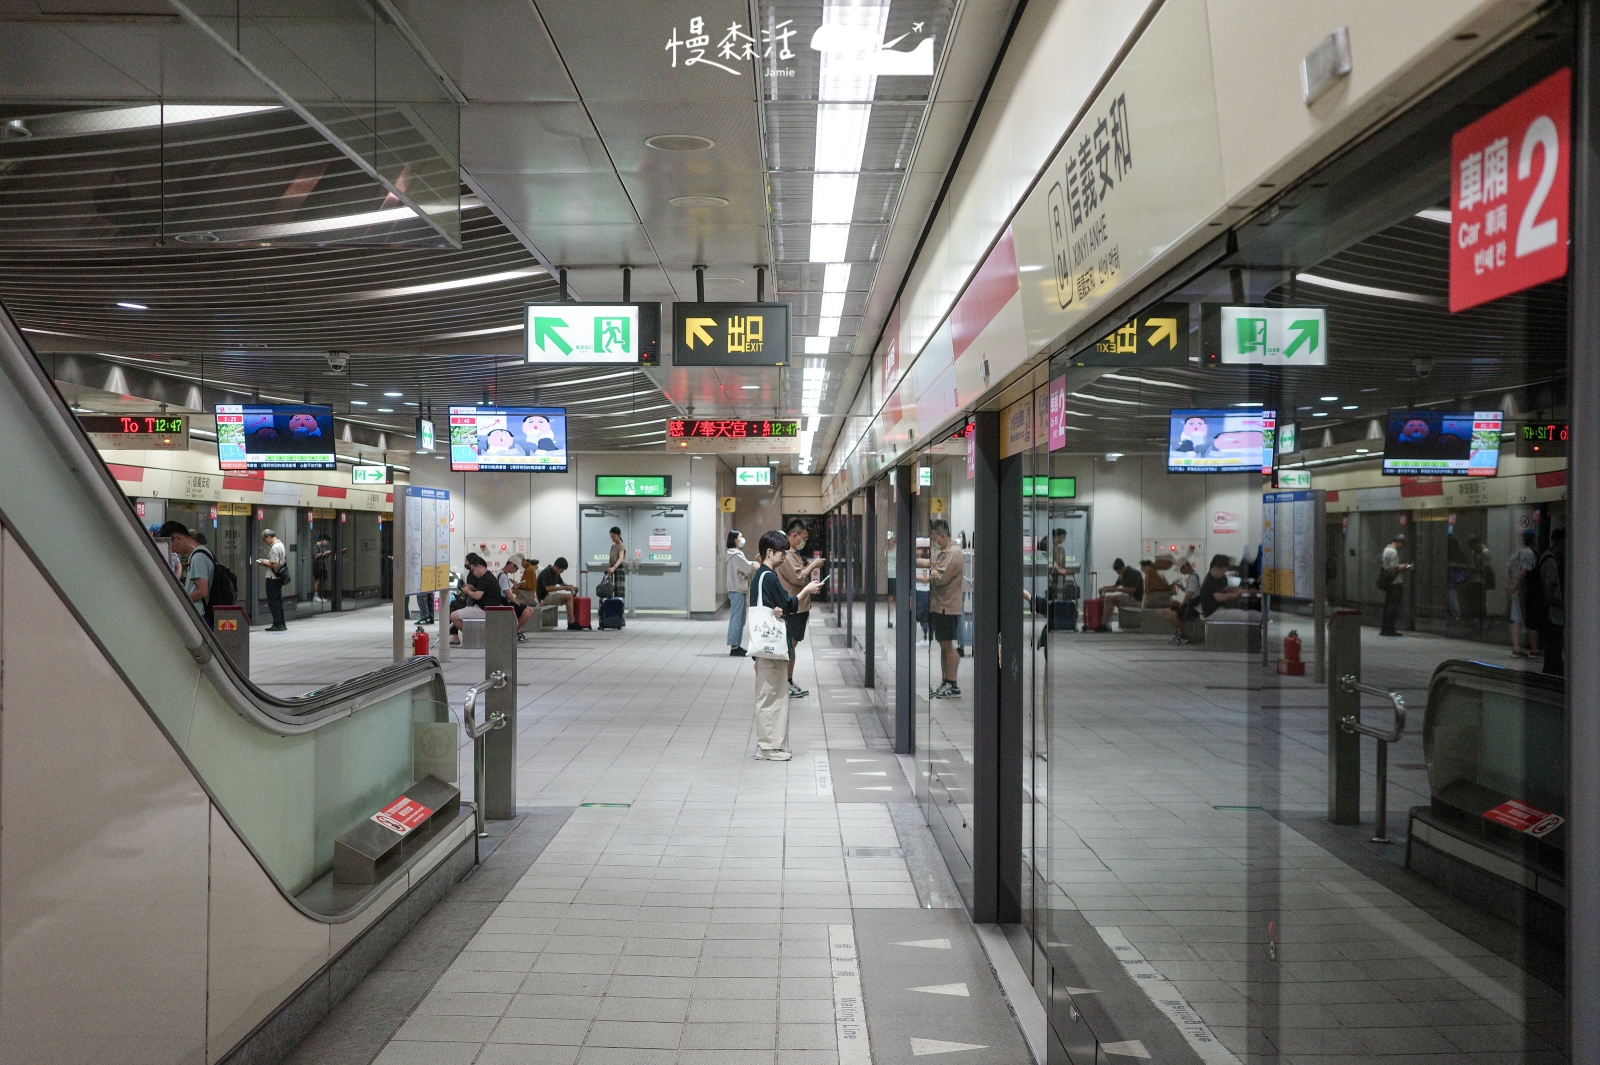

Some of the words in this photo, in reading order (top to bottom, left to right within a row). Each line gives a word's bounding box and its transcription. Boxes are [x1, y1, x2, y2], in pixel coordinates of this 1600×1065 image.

[1064, 91, 1133, 234] 信義安和
[1458, 136, 1509, 212] 車廂
[1515, 114, 1559, 258] 2
[1053, 203, 1062, 243] R
[1072, 231, 1090, 269] XINYI
[1089, 213, 1108, 254] ANHE
[1458, 221, 1481, 249] Car
[1057, 253, 1069, 291] 04
[727, 315, 764, 354] 出口
[745, 342, 764, 353] EXIT
[121, 417, 139, 433] To
[145, 417, 155, 433] T
[155, 419, 182, 432] 12:47
[771, 422, 798, 435] 12:47
[1058, 387, 1065, 437] 2
[838, 997, 858, 1022] Waiting
[843, 1024, 861, 1040] Line
